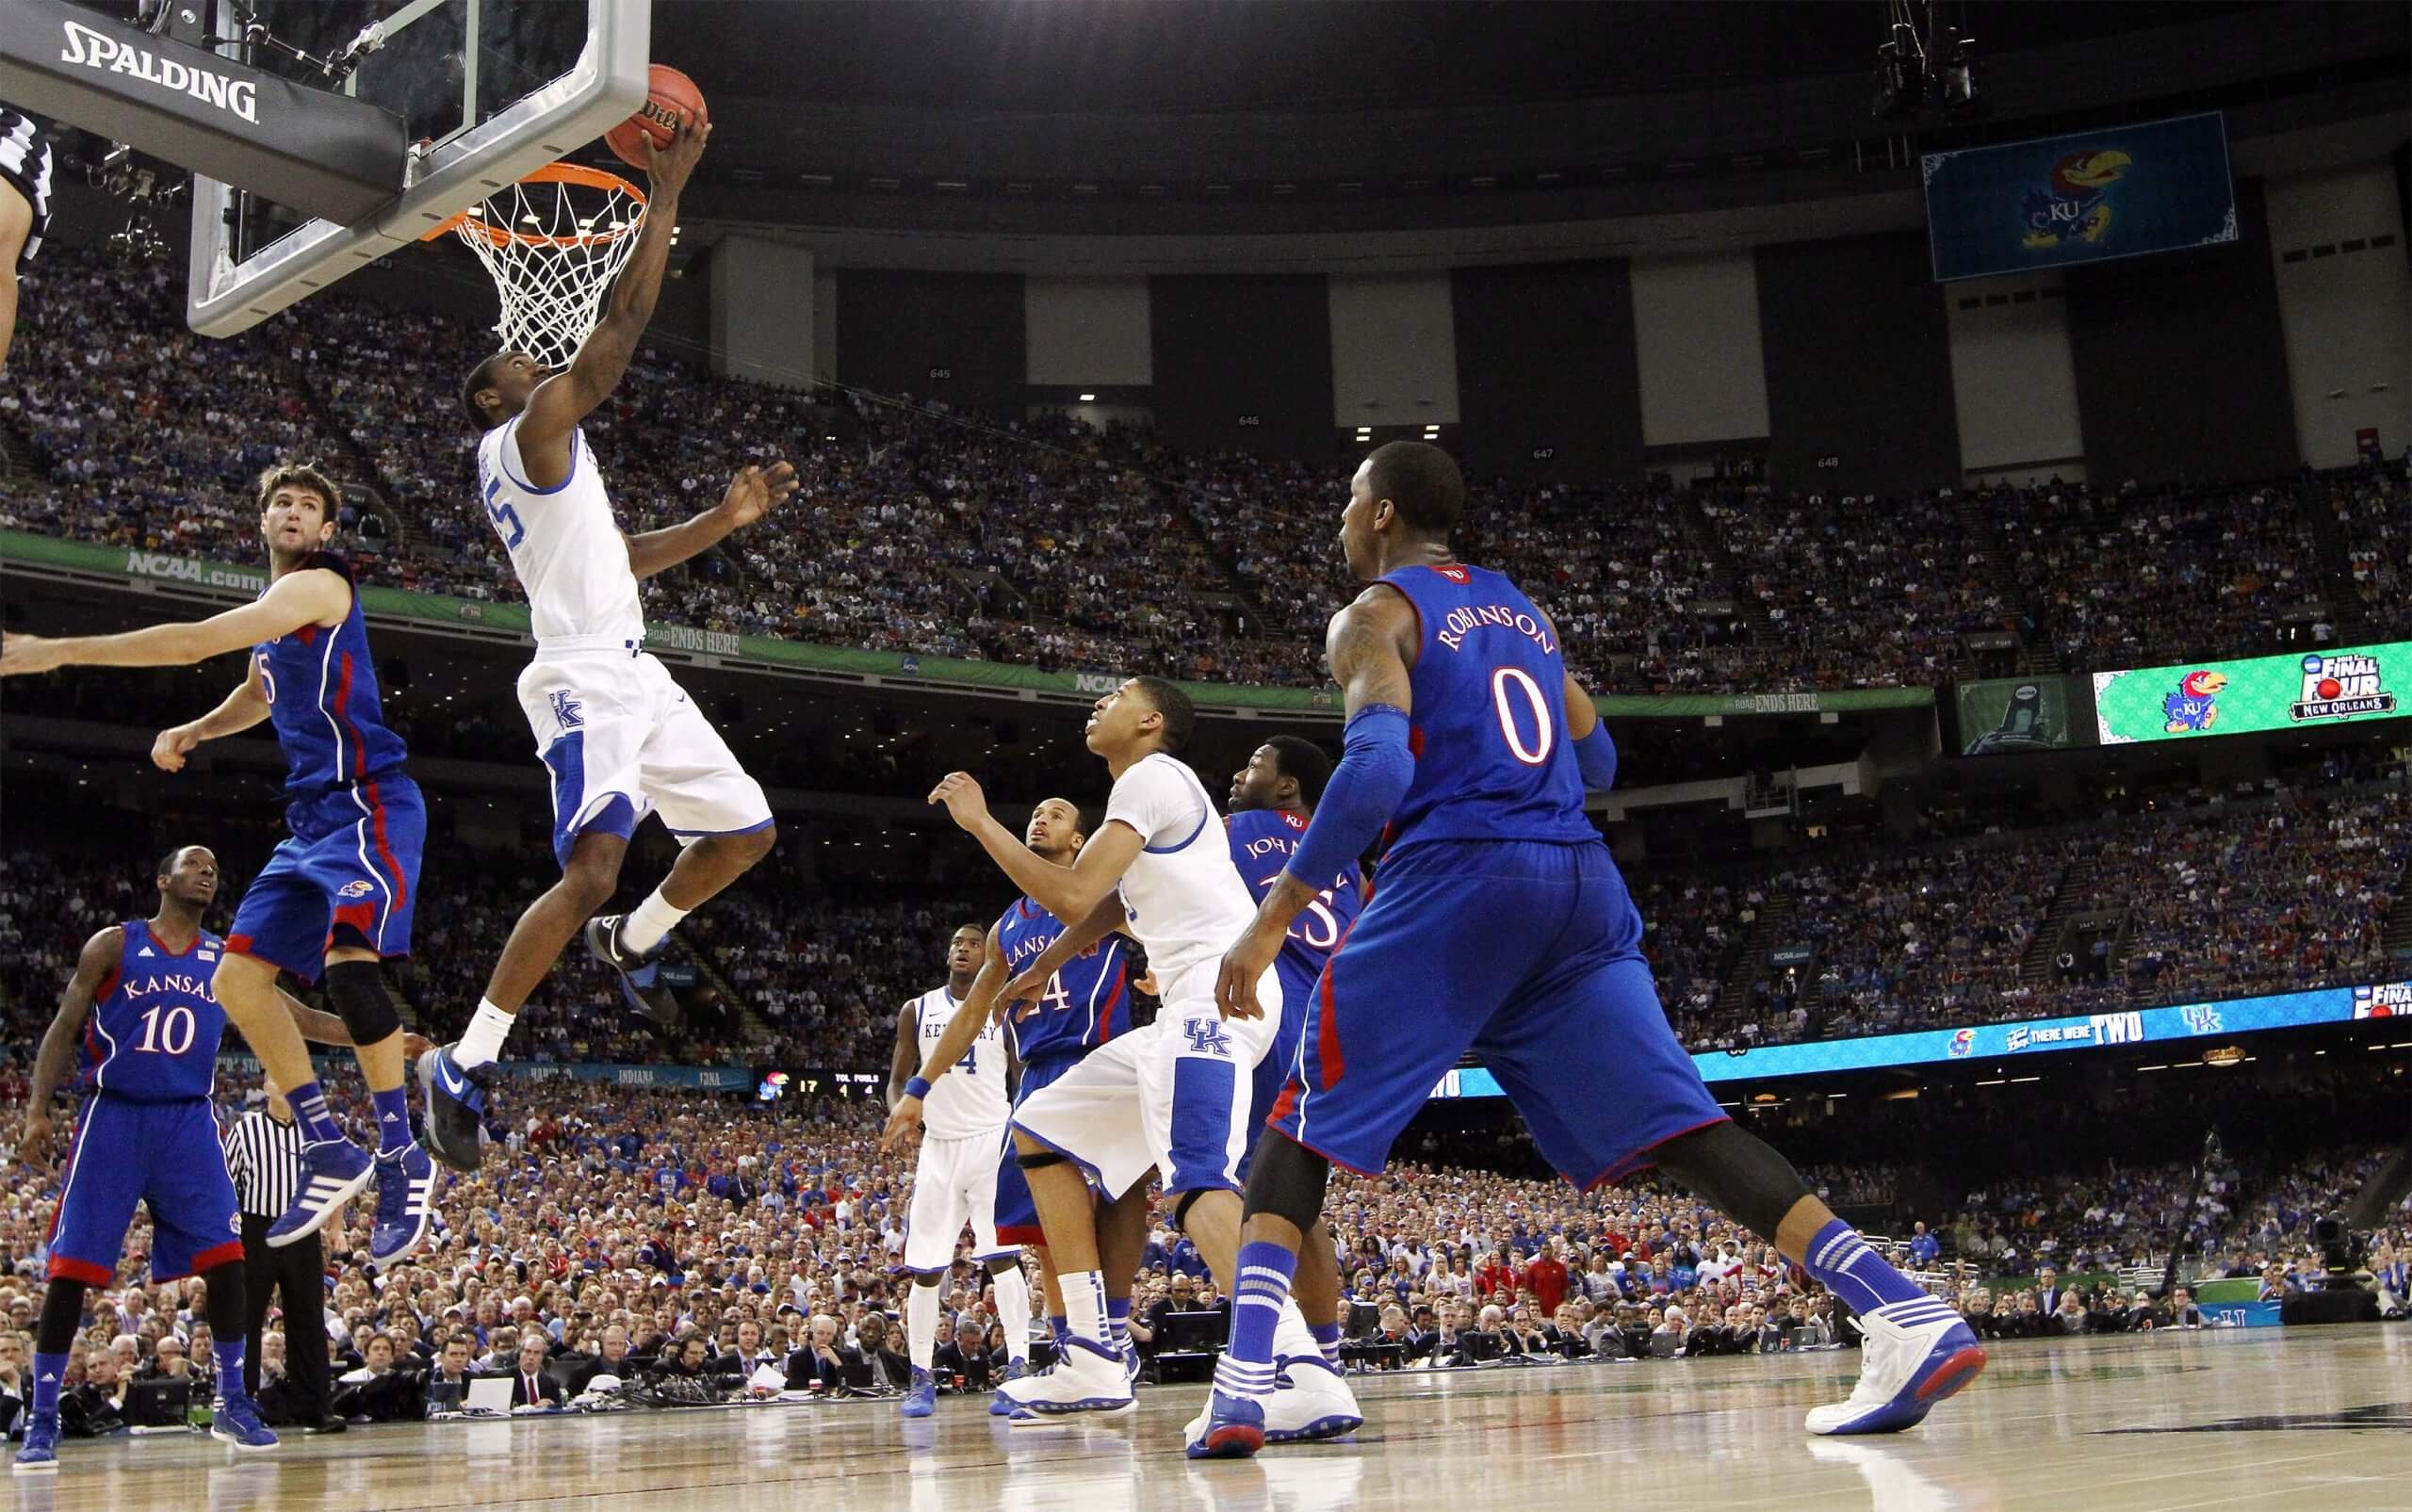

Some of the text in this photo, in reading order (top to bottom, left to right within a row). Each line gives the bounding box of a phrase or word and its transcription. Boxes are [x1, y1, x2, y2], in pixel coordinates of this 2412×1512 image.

[61, 21, 256, 124] SPALDING
[2050, 201, 2080, 221] KU
[1238, 415, 1260, 426] 646
[1532, 448, 1554, 460] 647
[126, 551, 266, 592] NCAA.com
[1438, 605, 1556, 656] ROBINSON
[647, 626, 740, 656] ROAD ENDS HERE
[2321, 658, 2377, 678] FINAL
[2301, 673, 2380, 702] FUR
[1755, 693, 1785, 712] ENDS
[1786, 692, 1819, 712] HERE
[2183, 702, 2201, 716] KU
[2303, 697, 2383, 717] NEW ORLEANS
[1493, 666, 1553, 765] 0
[1285, 814, 1303, 828] KU
[135, 1004, 196, 1056] 10
[2029, 1027, 2062, 1043] THERE
[2062, 1024, 2092, 1040] WERE
[2090, 1011, 2143, 1045] TWO
[800, 1080, 818, 1093] 17
[835, 1073, 879, 1082] TOL FOULS
[839, 1083, 848, 1097] 4
